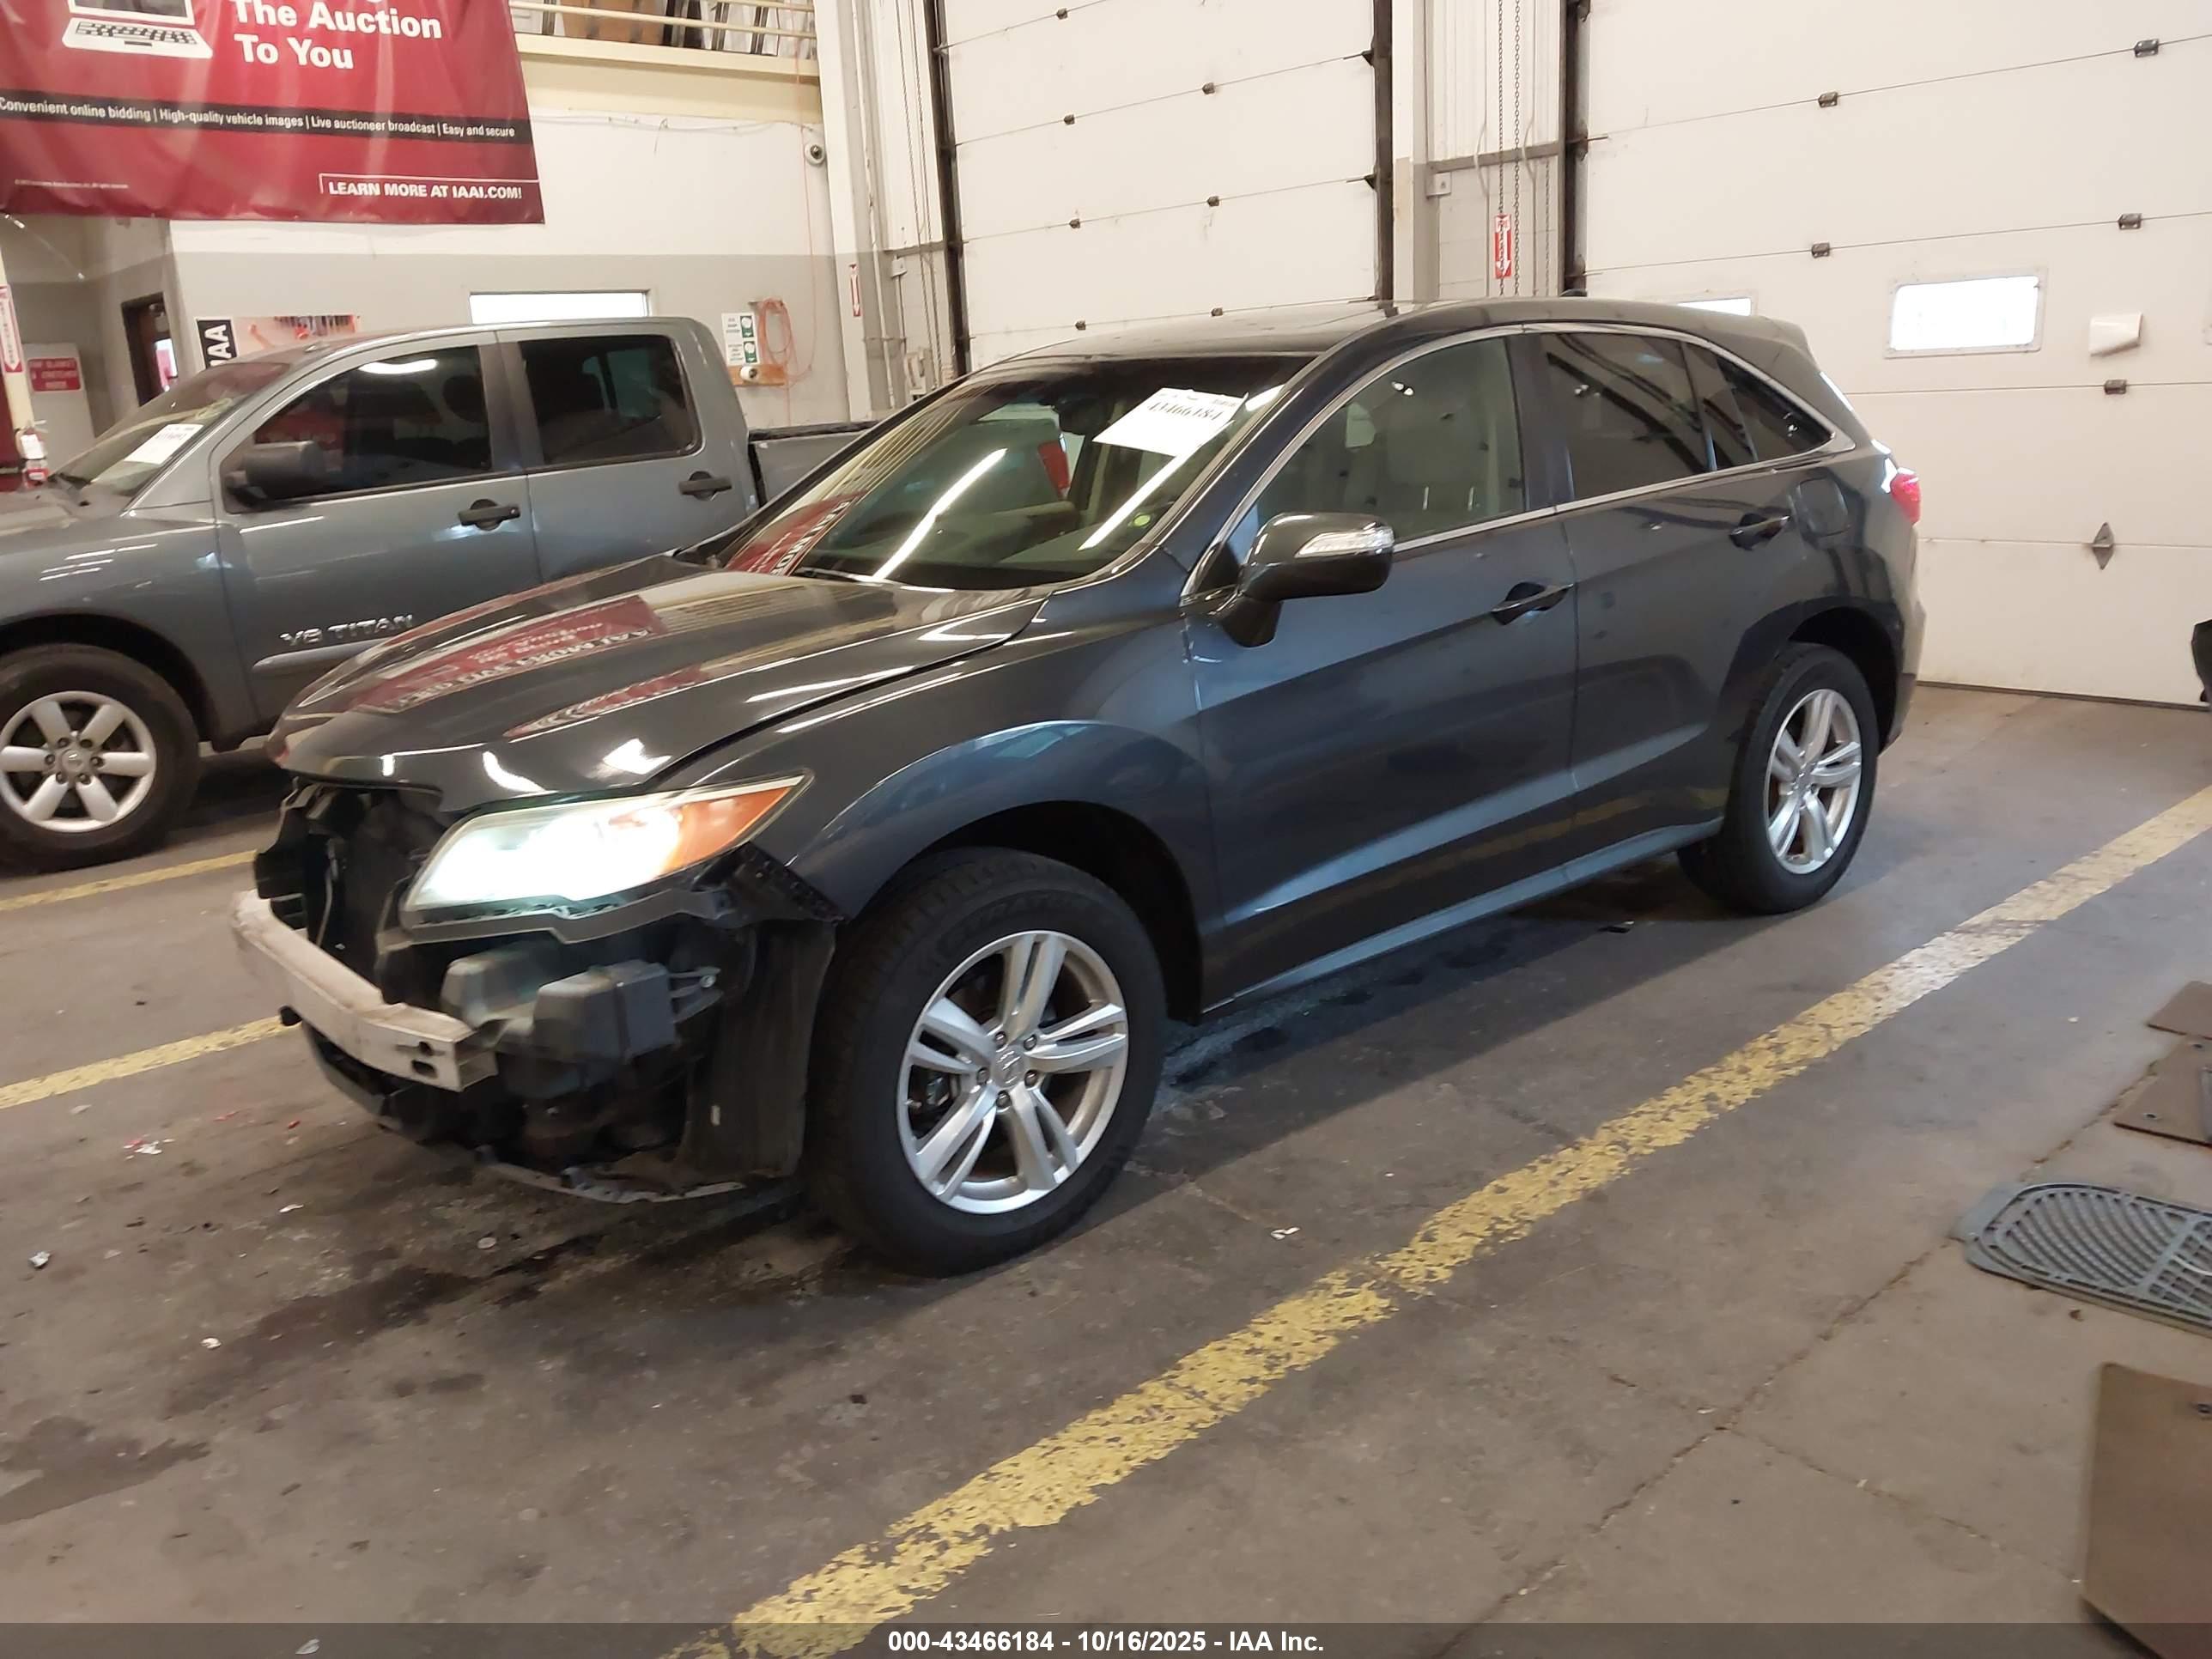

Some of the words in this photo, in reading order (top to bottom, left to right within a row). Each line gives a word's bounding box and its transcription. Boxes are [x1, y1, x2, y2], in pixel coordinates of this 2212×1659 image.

[230, 0, 297, 27] The
[309, 1, 442, 39] Auction
[234, 33, 279, 64] To
[286, 36, 354, 70] You
[0, 97, 68, 115] Convenient
[70, 104, 106, 118] online
[108, 106, 152, 123] bidding
[160, 107, 224, 125] High-quality
[225, 112, 263, 126] vehicle
[265, 113, 304, 129] images
[311, 115, 331, 128] Live
[333, 117, 386, 131] auctioneer
[388, 119, 435, 135] broadcast
[442, 123, 465, 137] Easy
[466, 123, 484, 137] and
[485, 127, 515, 137] secure
[328, 181, 380, 197] LEARN
[384, 183, 428, 198] MORE
[430, 185, 449, 198] AT
[452, 185, 522, 199] IAAI.COM!
[279, 628, 323, 647] V8
[327, 614, 413, 639] TITAN
